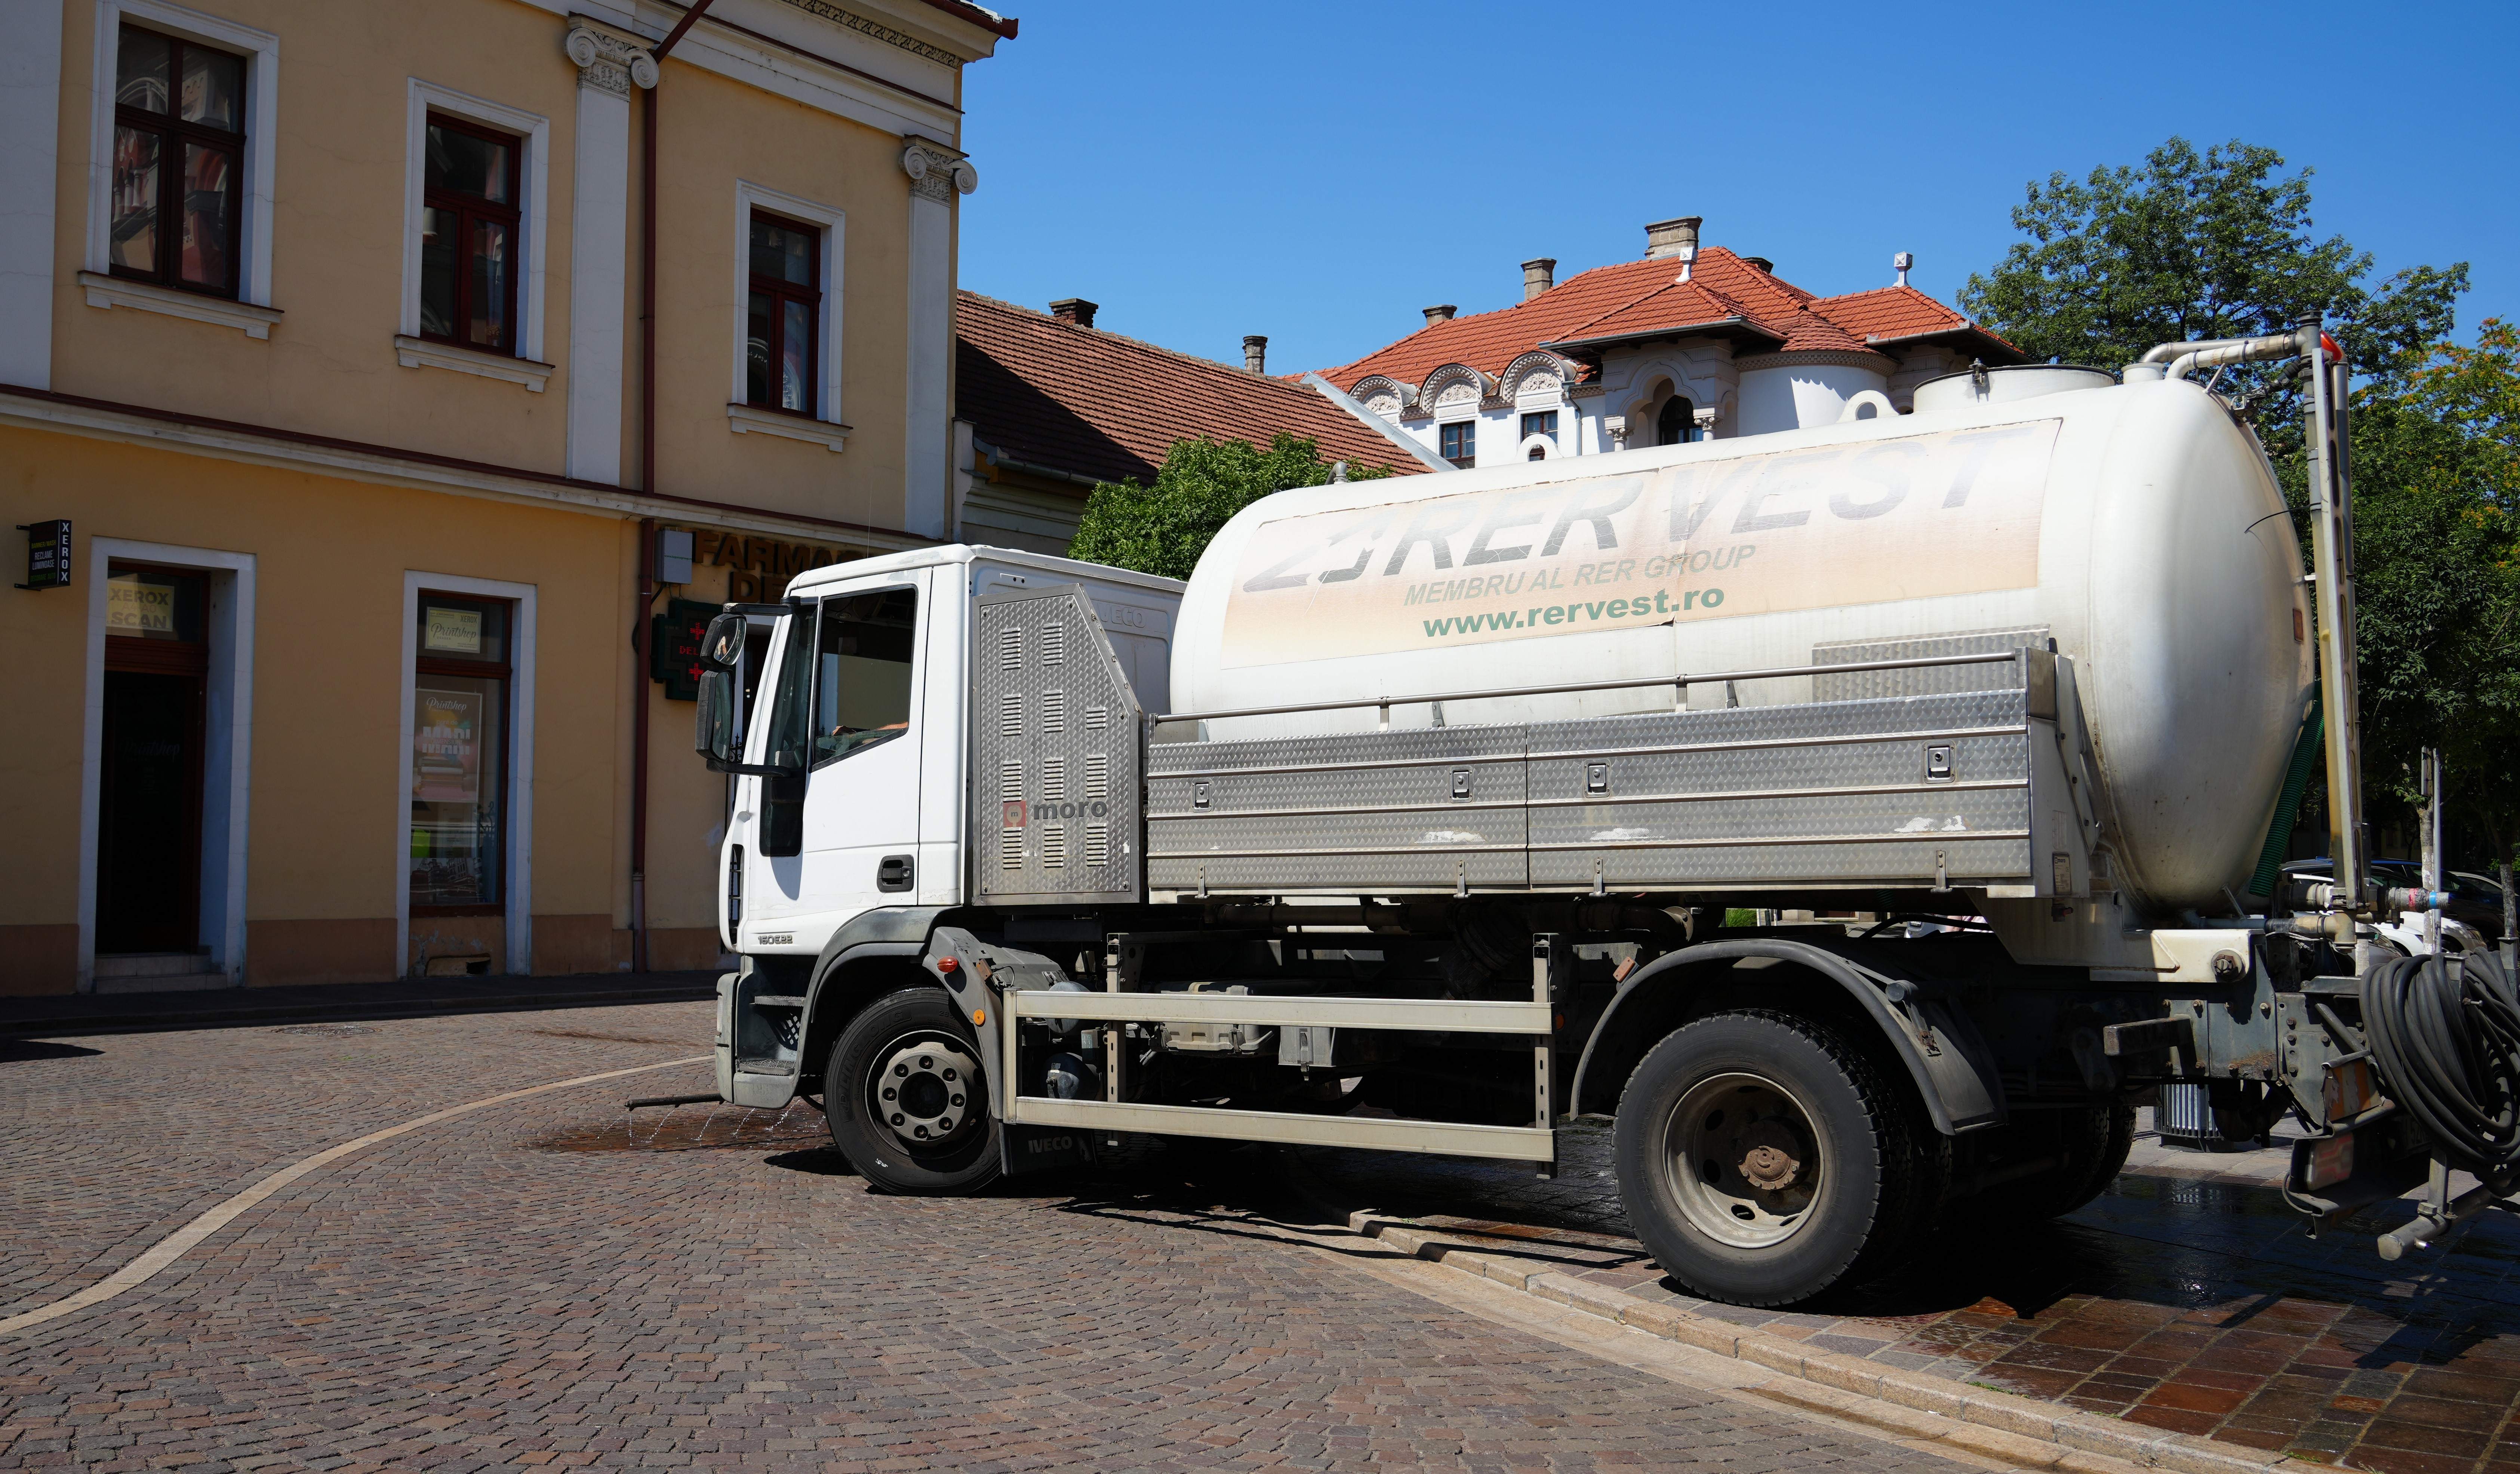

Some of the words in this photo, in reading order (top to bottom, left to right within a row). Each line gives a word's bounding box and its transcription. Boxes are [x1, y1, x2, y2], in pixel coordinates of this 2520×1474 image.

[1382, 477, 1644, 576] RER
[1669, 426, 2032, 542] VEST
[35, 550, 53, 560] RECLAME
[32, 559, 55, 570] LUMINOASE
[1403, 571, 1525, 606] MEMBRU
[1530, 567, 1564, 591] AL
[1573, 559, 1635, 588] RER
[1644, 544, 1756, 579] GROUP
[110, 588, 169, 605] XEROX
[111, 611, 167, 629] SCAN
[461, 615, 477, 623] XEROX
[1096, 602, 1145, 628] VECO
[1423, 586, 1724, 637] www.rervest.ro
[431, 623, 476, 642] Printshop
[426, 697, 467, 714] Printshop
[1034, 801, 1107, 820] moro
[1028, 1136, 1073, 1154] IVECO
